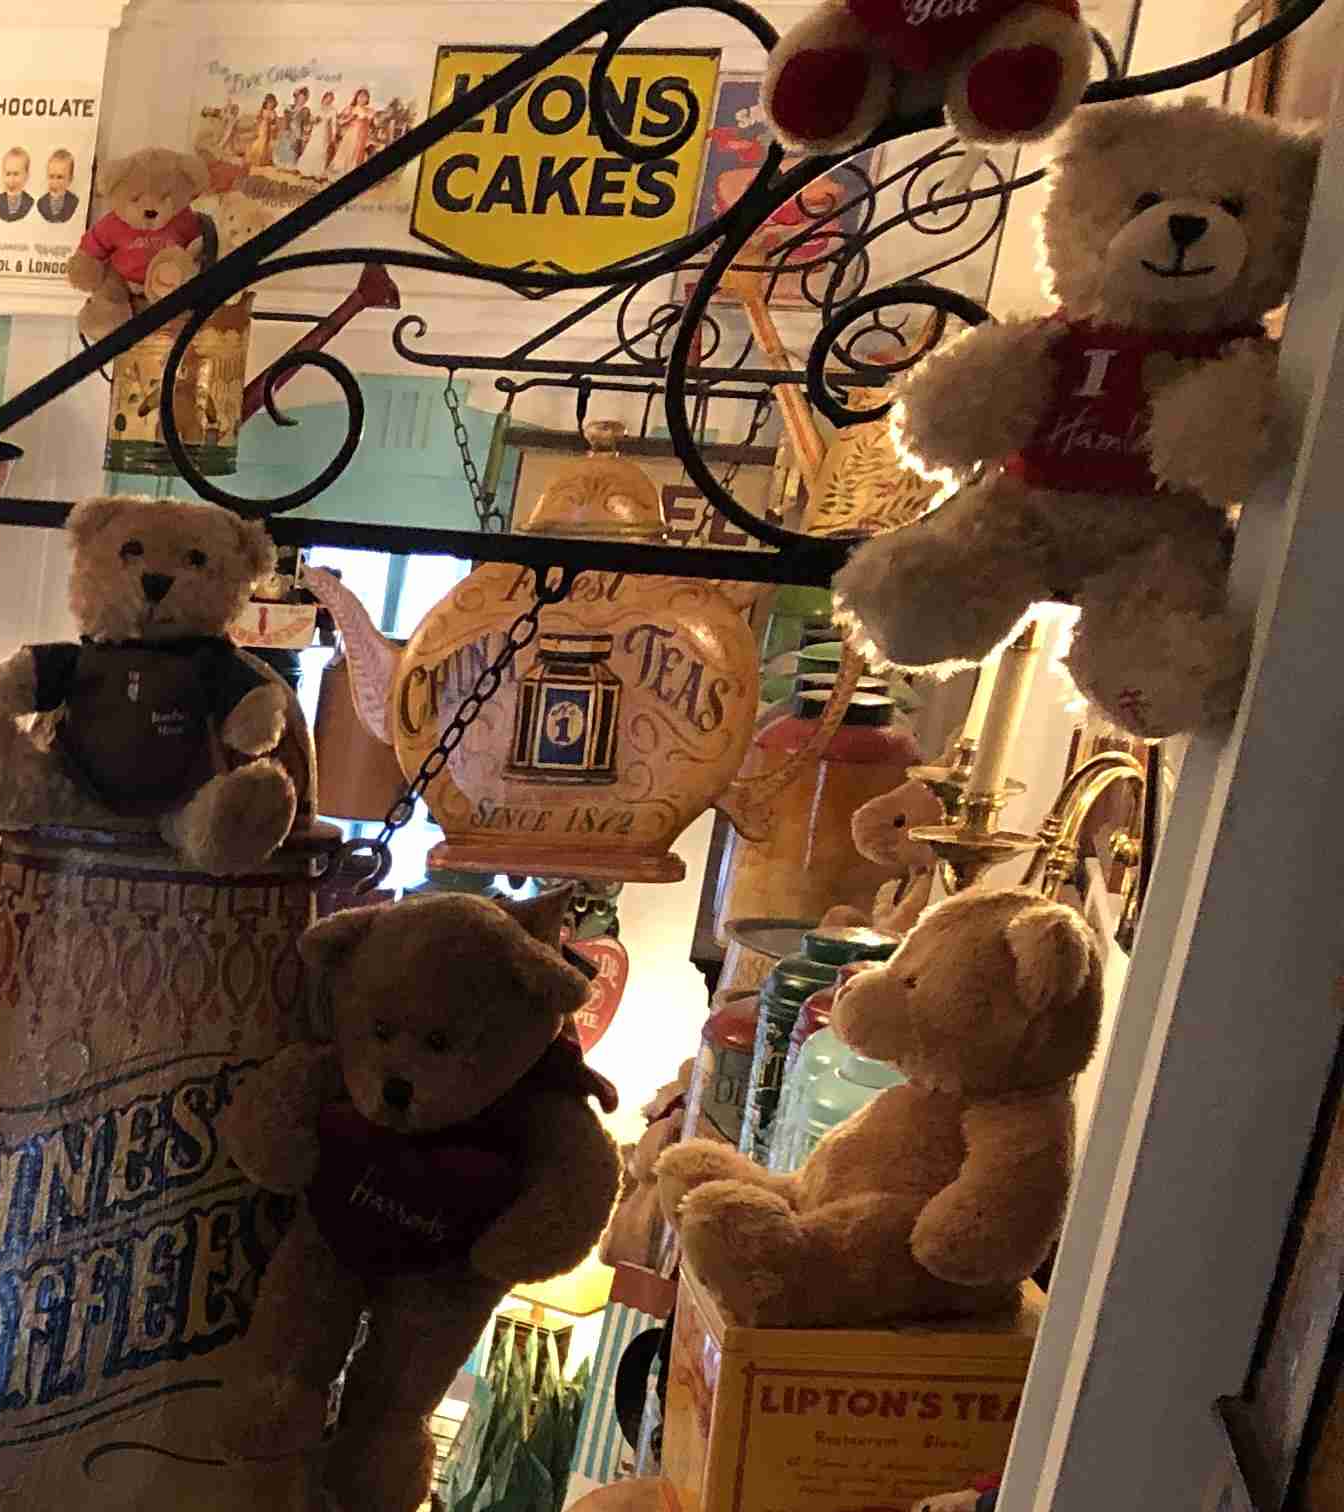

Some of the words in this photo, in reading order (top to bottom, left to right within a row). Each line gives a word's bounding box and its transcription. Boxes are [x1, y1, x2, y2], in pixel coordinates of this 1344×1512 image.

[431, 153, 680, 219] CAKES
[623, 623, 729, 733] TEAS
[469, 797, 553, 832] SINCE
[758, 1384, 944, 1422] LIPTON'S
